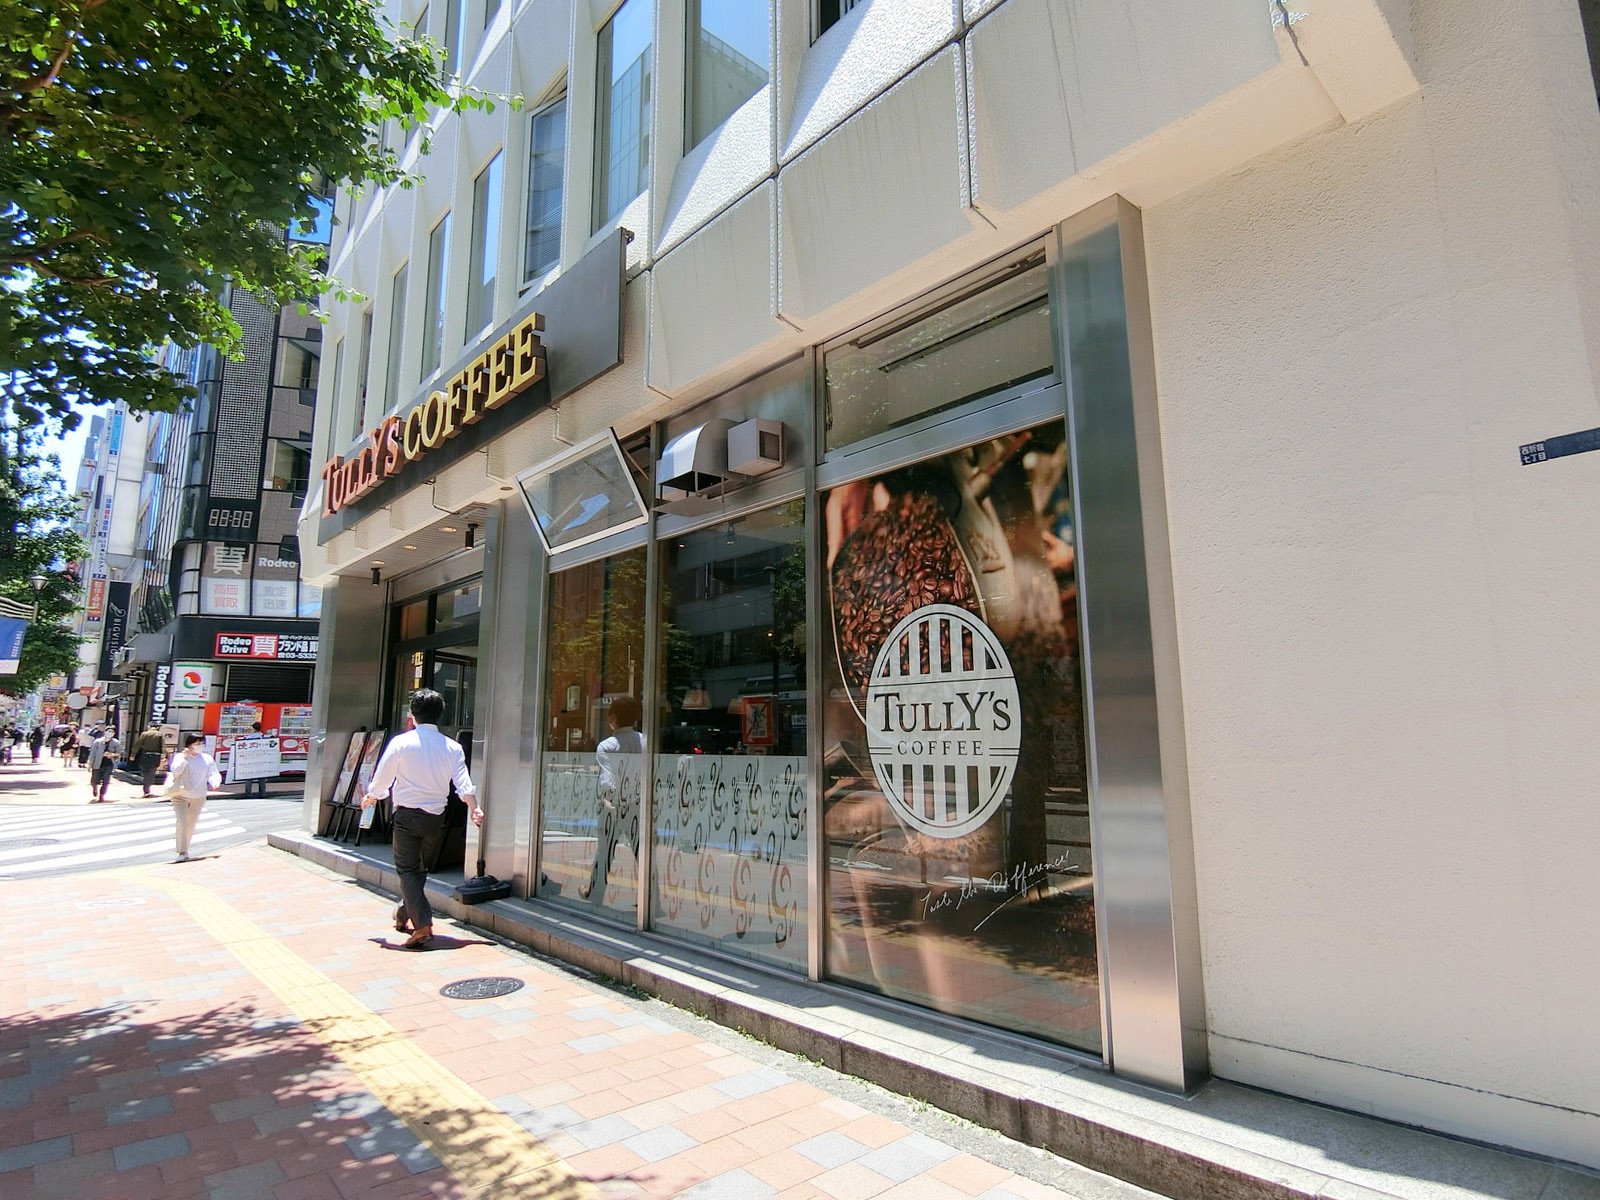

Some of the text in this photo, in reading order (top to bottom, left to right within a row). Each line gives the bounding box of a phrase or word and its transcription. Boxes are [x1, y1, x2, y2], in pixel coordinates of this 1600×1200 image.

[404, 312, 542, 461] COFFEE
[258, 557, 297, 569] Rodeo
[214, 584, 239, 596] 高価
[214, 597, 239, 609] 買取
[220, 636, 252, 646] Rodeo
[254, 635, 277, 657] 質
[221, 644, 249, 654] Drive
[151, 665, 171, 726] Rodeo Dri
[873, 689, 1012, 733] TULLY'S
[897, 740, 984, 756] COFFEE
